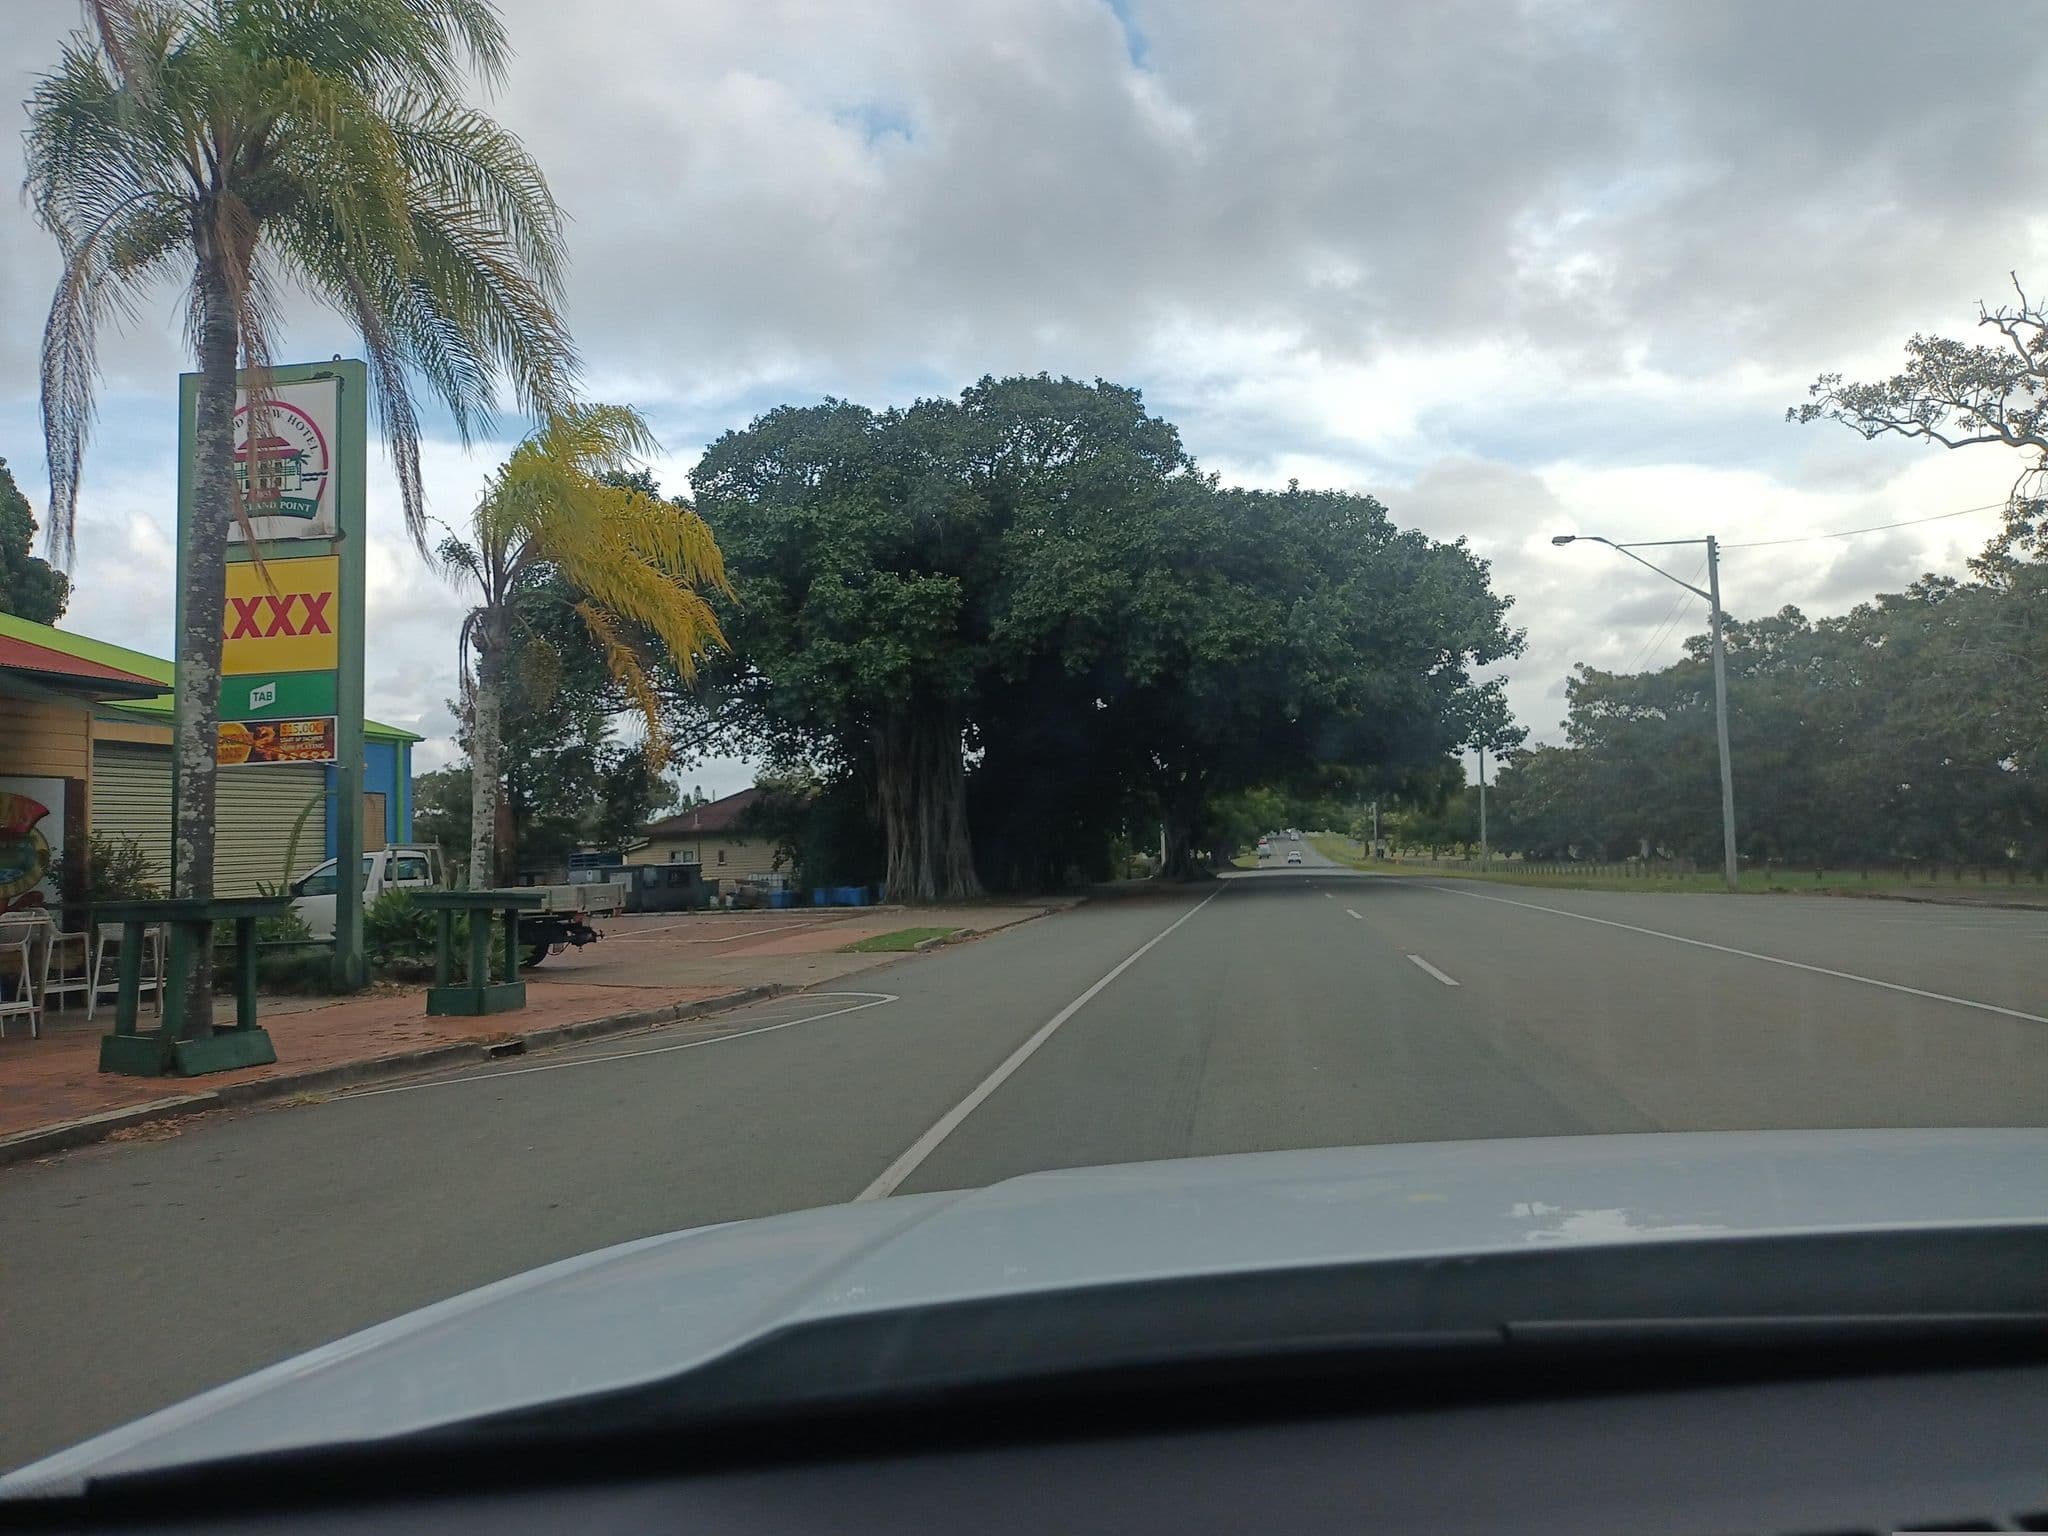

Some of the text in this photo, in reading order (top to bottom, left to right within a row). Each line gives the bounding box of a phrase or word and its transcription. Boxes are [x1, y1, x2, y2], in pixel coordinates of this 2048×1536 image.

[287, 414, 319, 454] HOTEL
[280, 501, 312, 512] POINT
[223, 592, 332, 640] XXX
[252, 690, 273, 702] TAB
